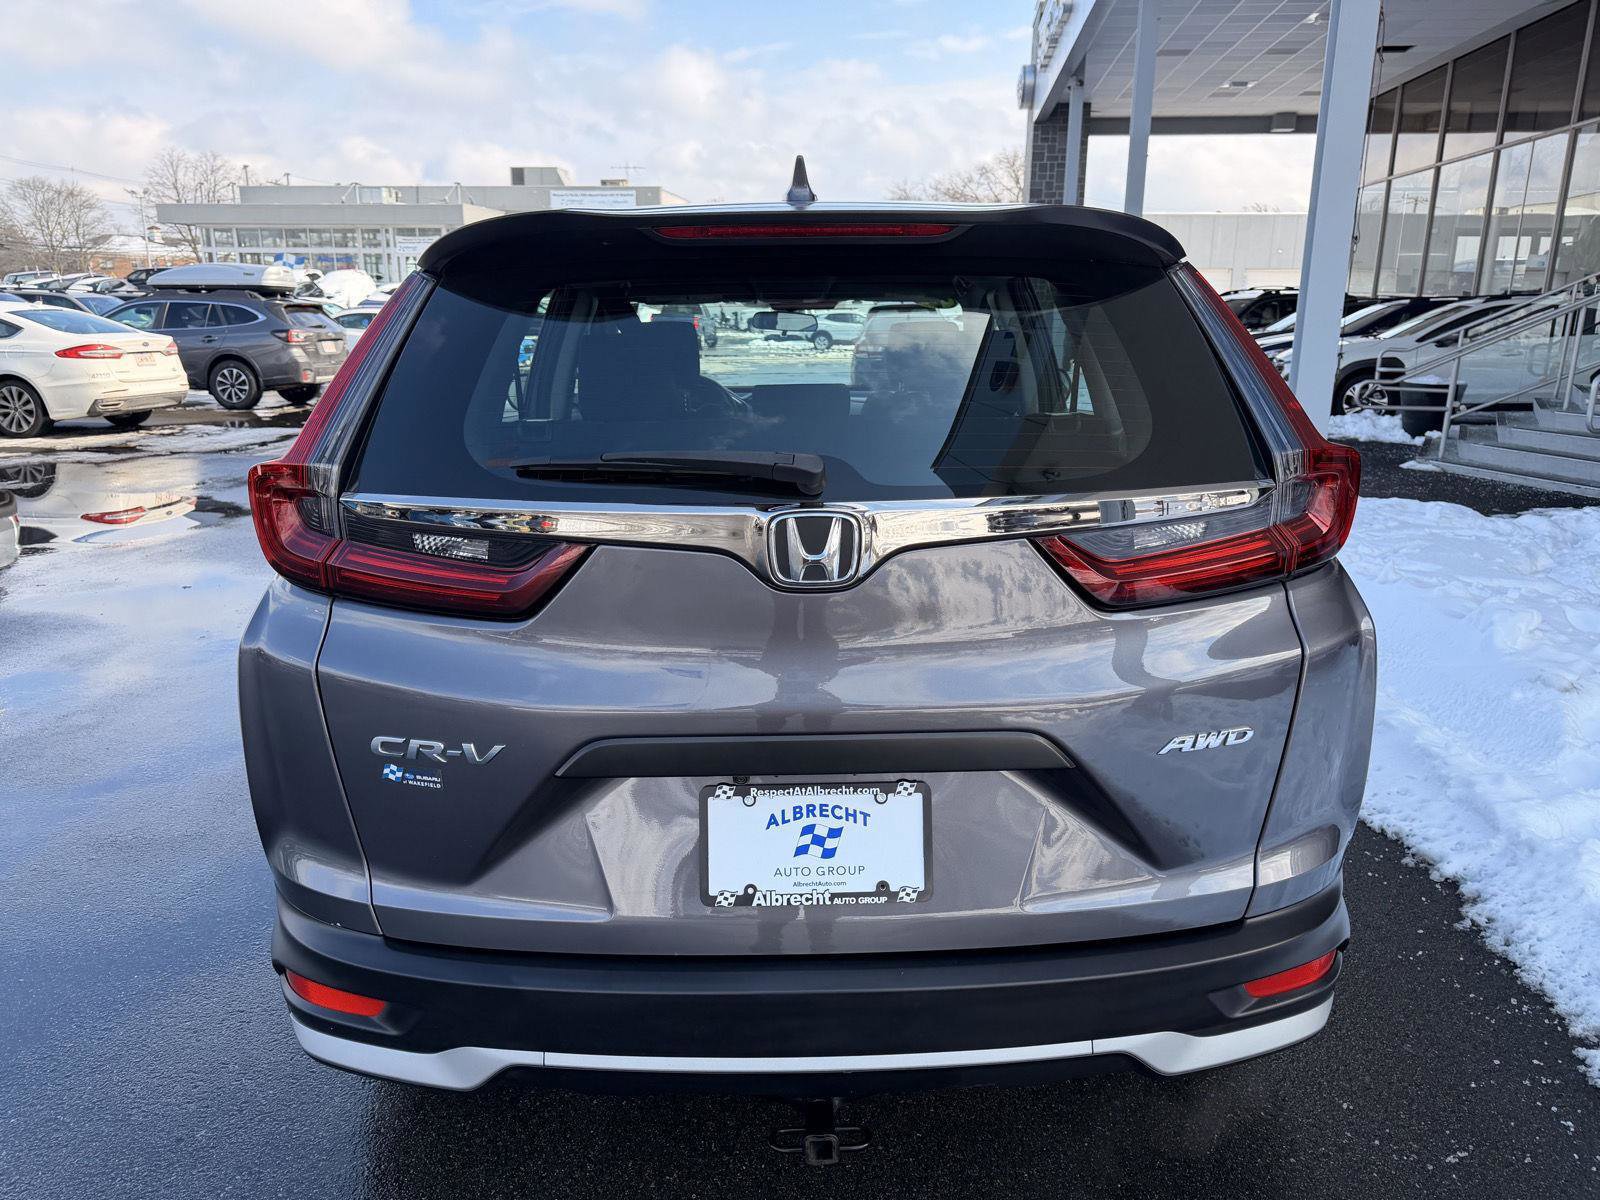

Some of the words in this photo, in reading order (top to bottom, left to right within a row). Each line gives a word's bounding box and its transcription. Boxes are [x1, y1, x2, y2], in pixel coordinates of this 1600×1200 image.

[1157, 727, 1254, 755] AWD
[371, 736, 506, 764] CR-V
[408, 780, 441, 789] WAKEFIELD
[750, 786, 880, 799] RespectAtAlbrecht.com
[765, 803, 871, 830] ALBRECHT
[773, 866, 811, 877] AUTO
[816, 865, 866, 876] GROUP
[792, 880, 847, 888] AlbrechtAuto.com
[752, 889, 832, 907] Albrecht
[858, 896, 888, 904] GROUP
